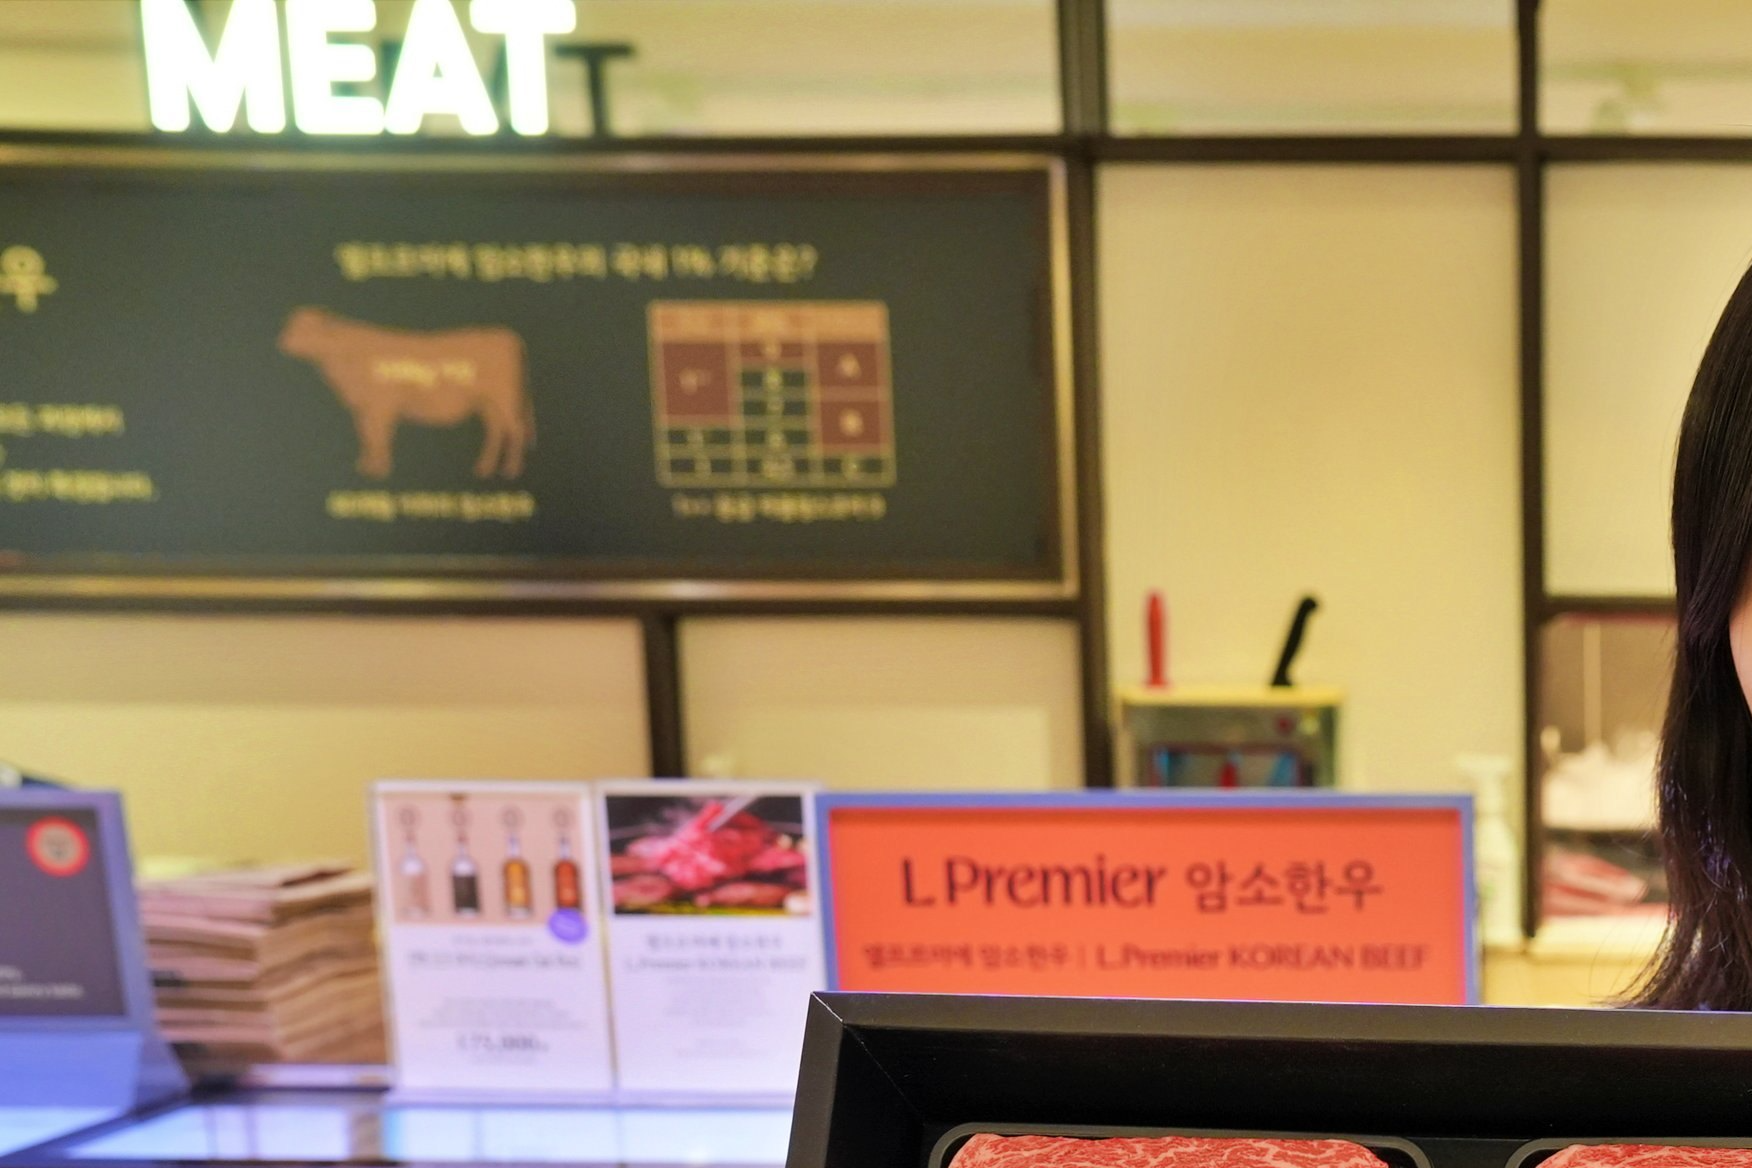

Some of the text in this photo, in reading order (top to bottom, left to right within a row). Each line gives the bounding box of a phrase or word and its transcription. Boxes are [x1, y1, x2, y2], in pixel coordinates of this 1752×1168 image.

[139, 0, 577, 135] MEAT
[901, 852, 1384, 914] L Premier 암소한우
[978, 942, 1069, 971] 암소한우
[1228, 943, 1354, 970] KOREAN
[1360, 943, 1427, 970] BEEF
